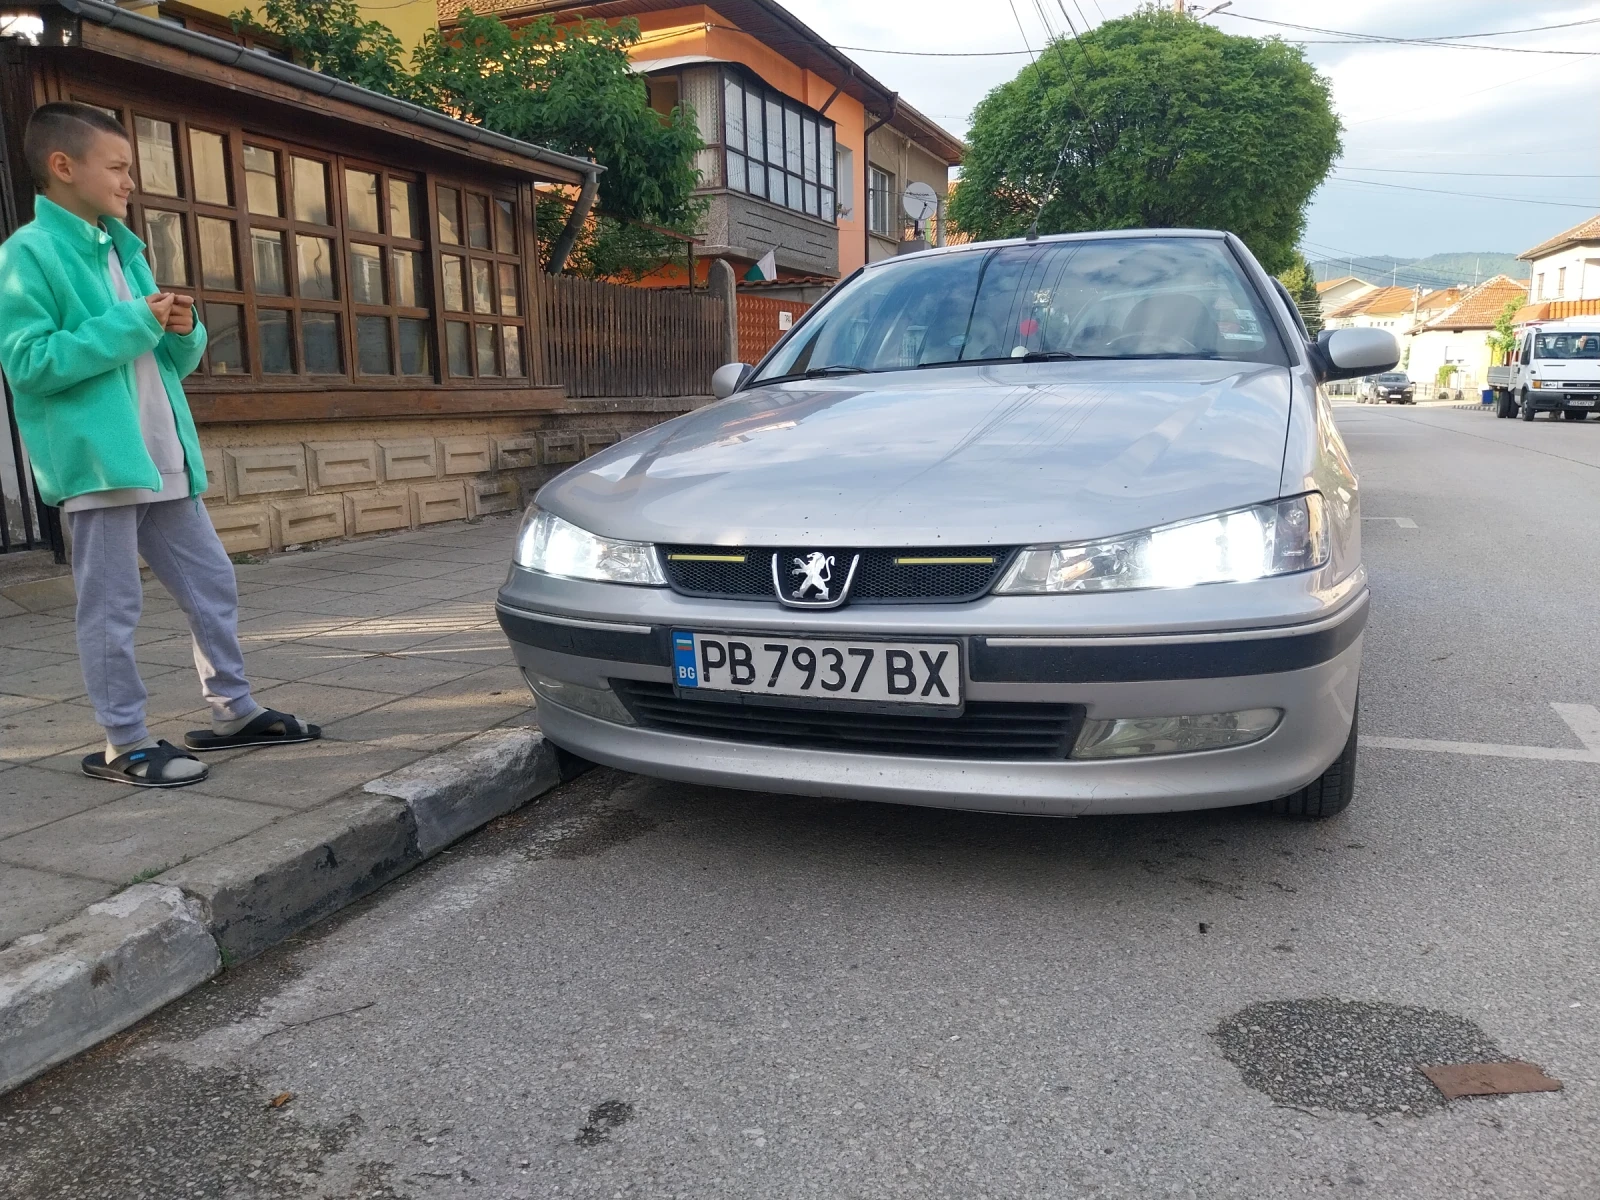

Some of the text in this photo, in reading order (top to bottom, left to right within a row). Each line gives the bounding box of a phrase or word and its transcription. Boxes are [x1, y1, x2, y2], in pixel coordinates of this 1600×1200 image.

[678, 665, 696, 680] BG
[700, 639, 951, 698] PB 7937 BX
